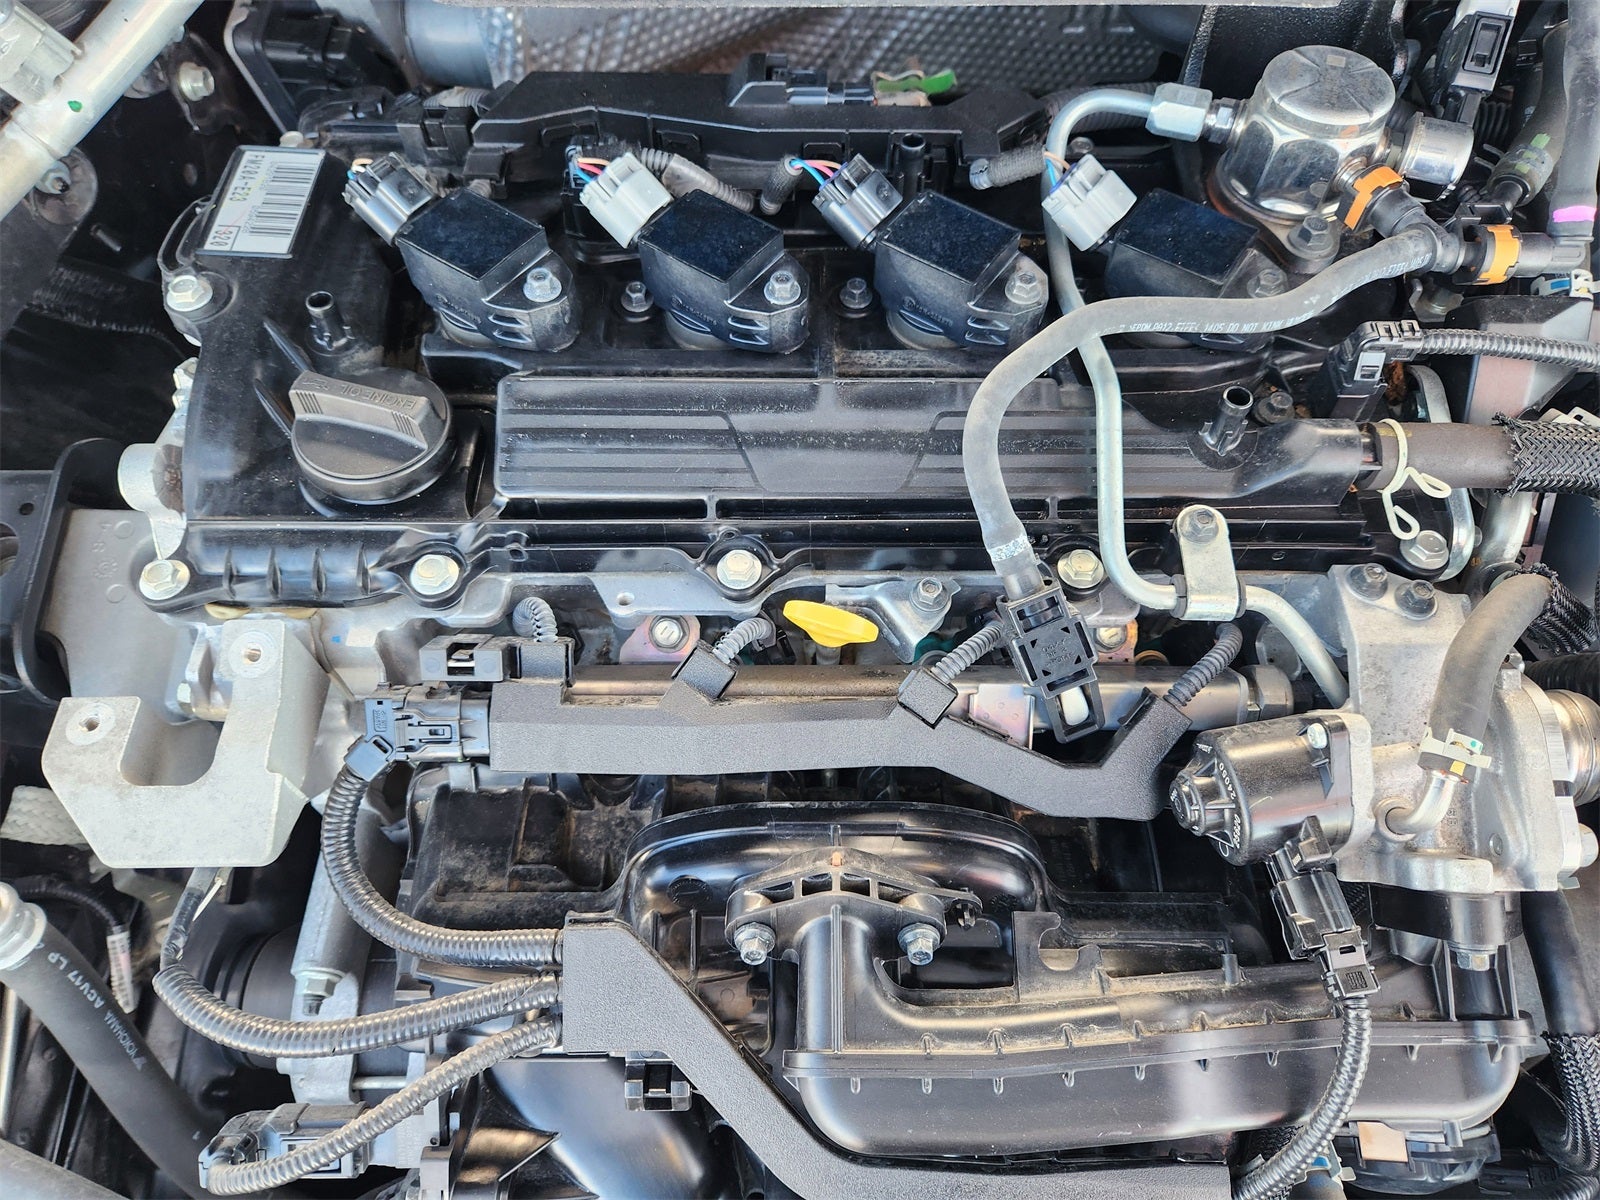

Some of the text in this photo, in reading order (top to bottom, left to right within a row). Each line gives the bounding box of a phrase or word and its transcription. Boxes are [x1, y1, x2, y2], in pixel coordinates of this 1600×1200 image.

[209, 230, 233, 246] 320
[341, 384, 416, 410] ENGINE OIL
[1218, 762, 1236, 799] 24050
[47, 951, 68, 969] LP
[67, 969, 105, 1009] ACV17
[103, 1009, 140, 1058] YOKOHAMA
